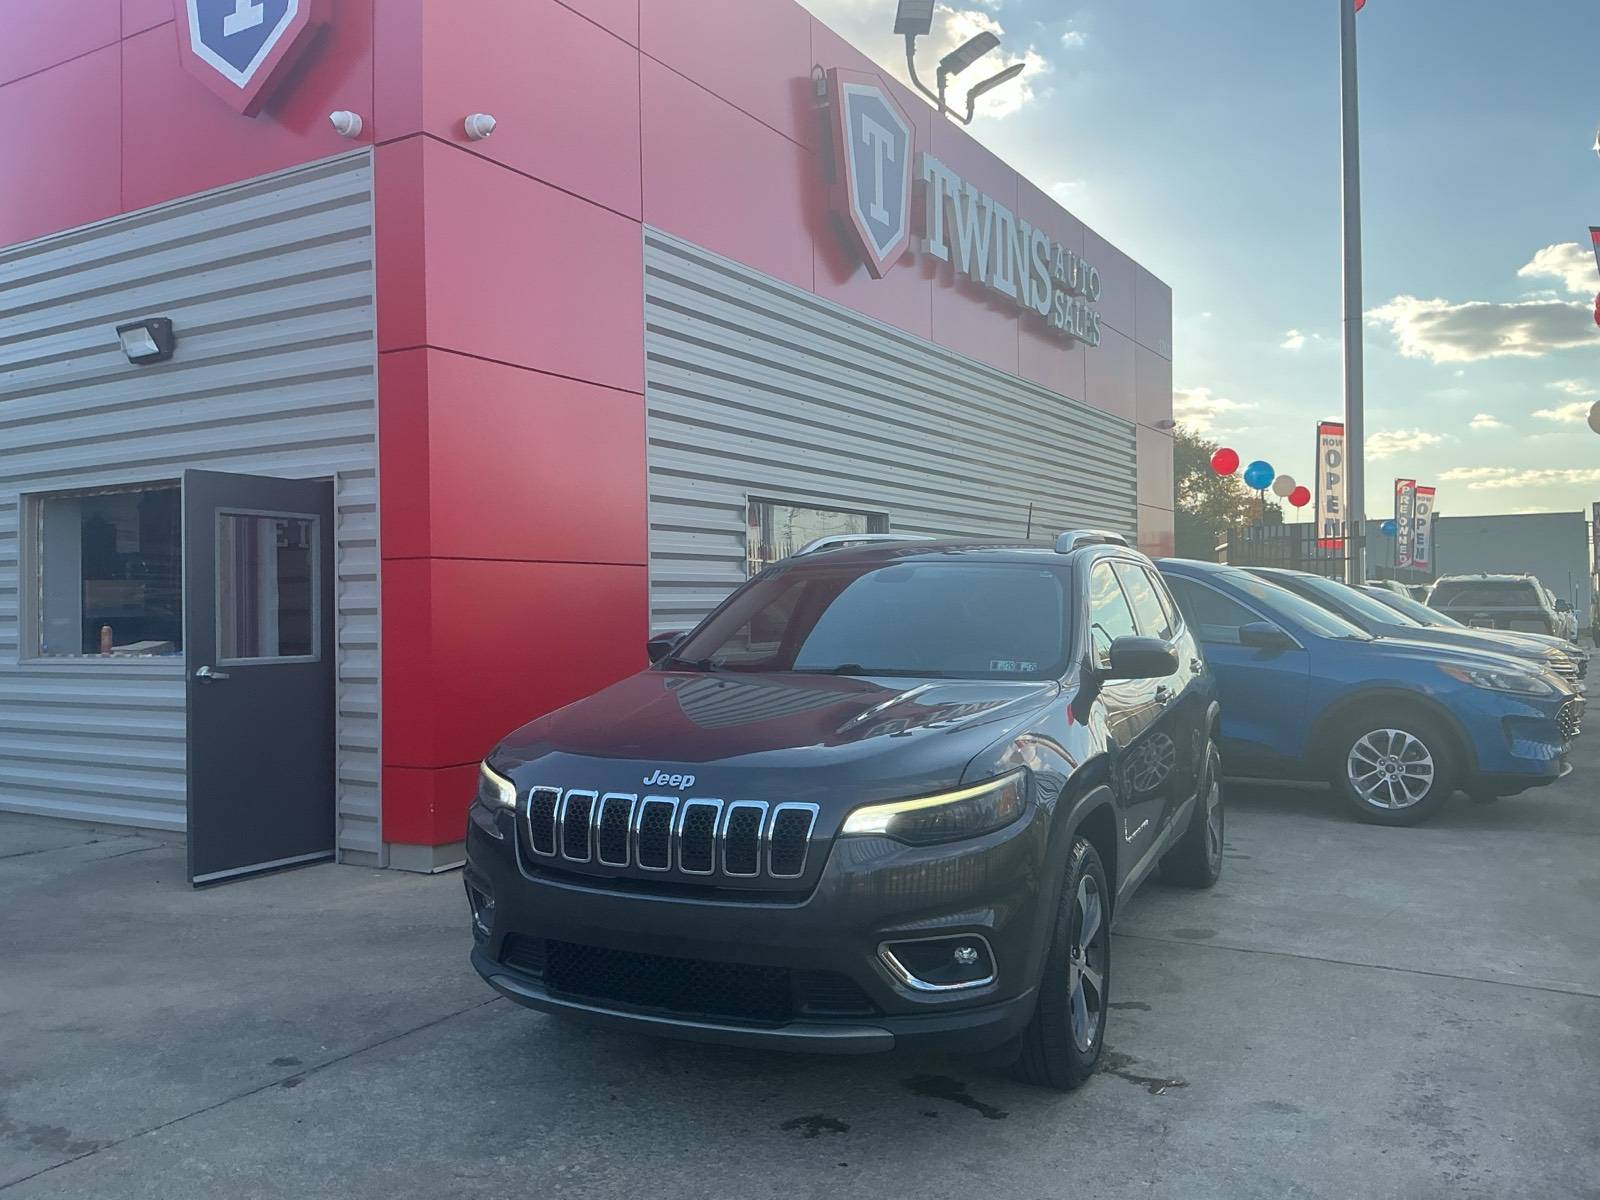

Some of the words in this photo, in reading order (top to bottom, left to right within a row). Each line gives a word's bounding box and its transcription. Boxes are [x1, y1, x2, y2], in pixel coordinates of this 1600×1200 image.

[862, 112, 896, 226] T
[923, 152, 1051, 316] TWINS
[1056, 243, 1101, 302] AUTO
[1055, 290, 1101, 346] SALES
[1322, 437, 1343, 446] NOW
[1325, 449, 1342, 537] OPEN
[1416, 503, 1429, 560] OPEN
[643, 769, 695, 790] Jeep
